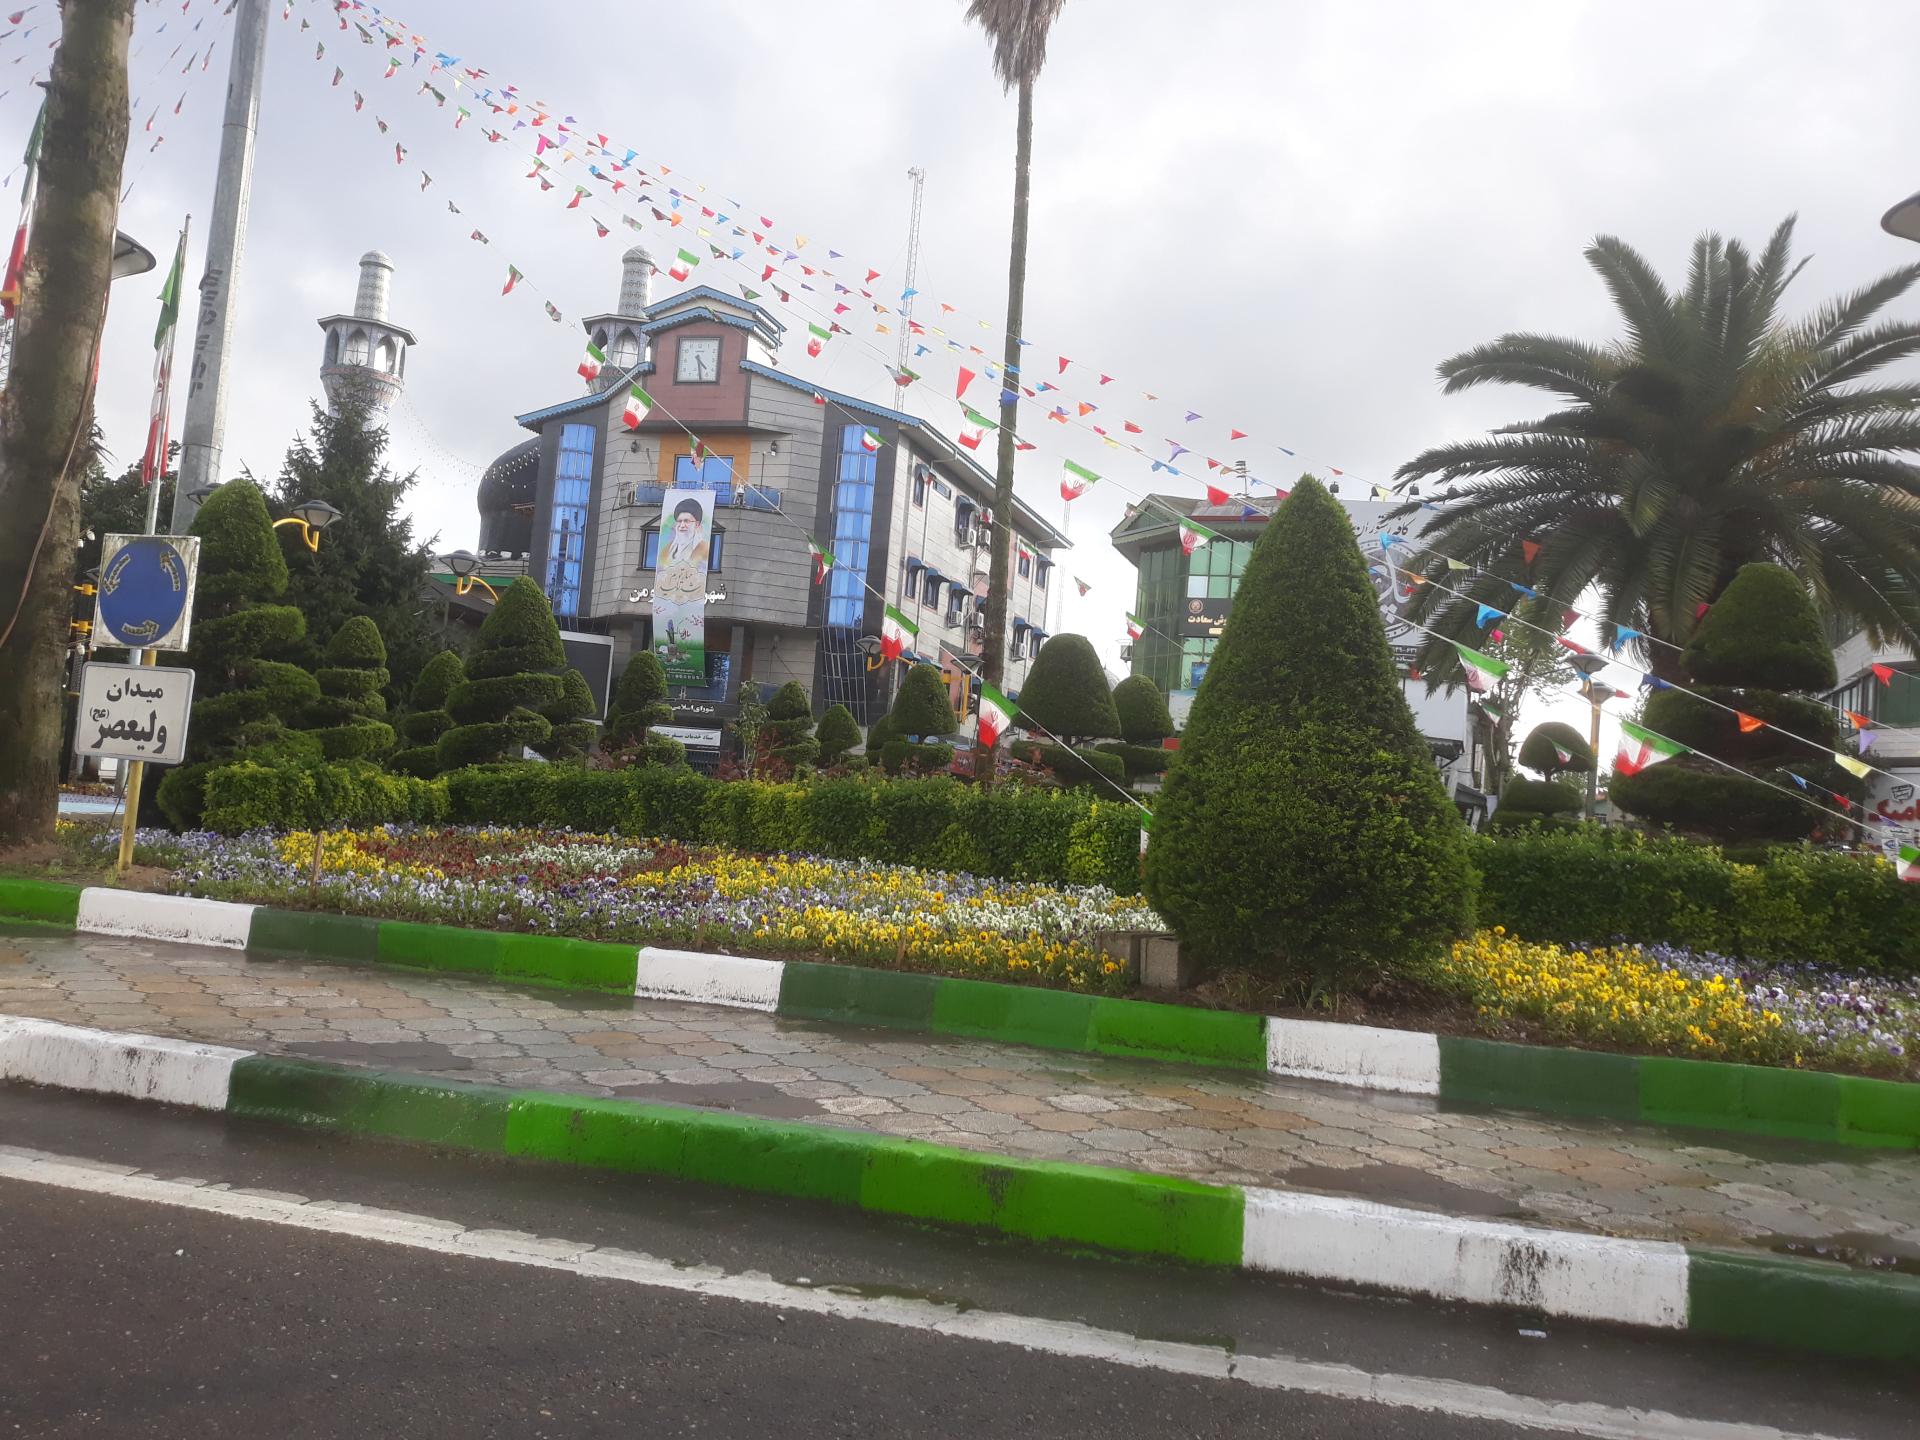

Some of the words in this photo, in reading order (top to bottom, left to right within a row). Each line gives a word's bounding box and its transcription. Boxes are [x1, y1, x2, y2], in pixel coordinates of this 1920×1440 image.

[106, 677, 164, 703] میدان
[89, 706, 110, 722] (عج)
[693, 704, 715, 714] شورای
[91, 709, 167, 754] ولیعصر
